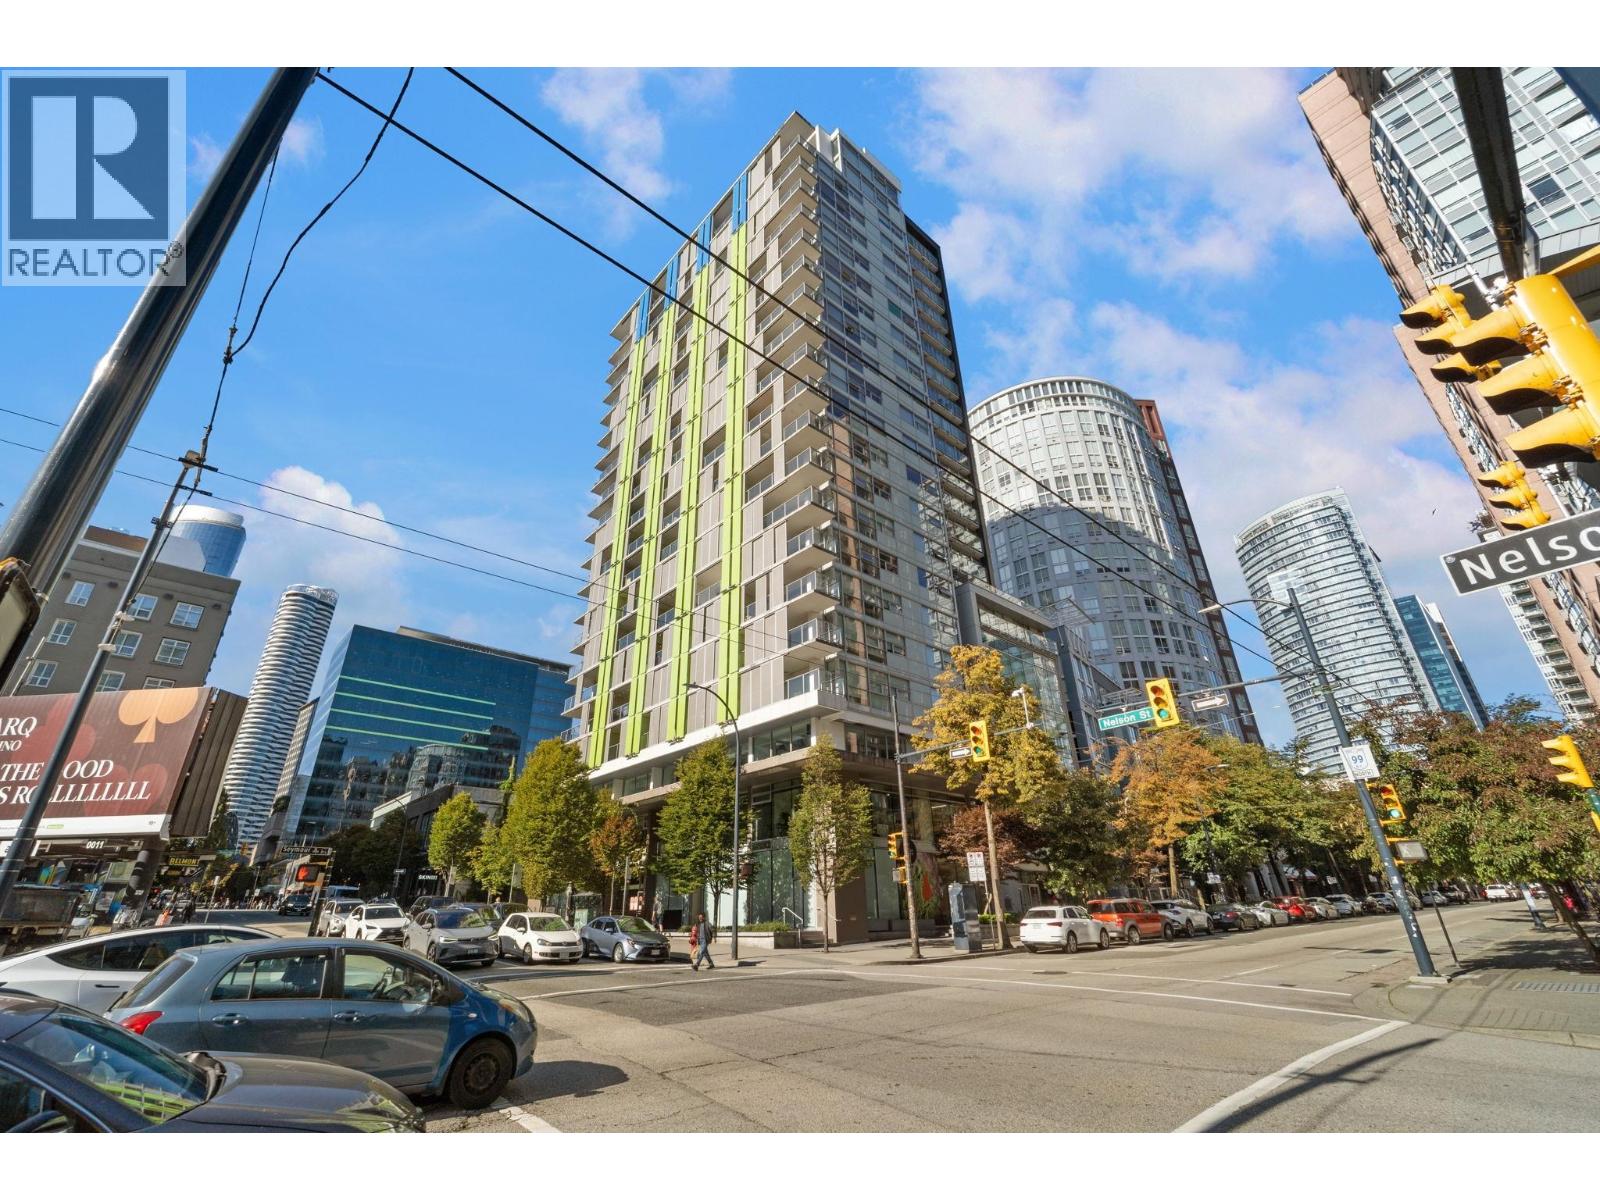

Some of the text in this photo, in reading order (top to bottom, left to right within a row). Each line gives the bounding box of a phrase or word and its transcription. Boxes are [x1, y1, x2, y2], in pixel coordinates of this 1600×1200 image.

[1103, 709, 1152, 727] Nelson St
[0, 717, 38, 738] RQ
[1351, 754, 1364, 764] 99
[0, 760, 114, 781] THE OOD
[86, 840, 105, 849] 0011
